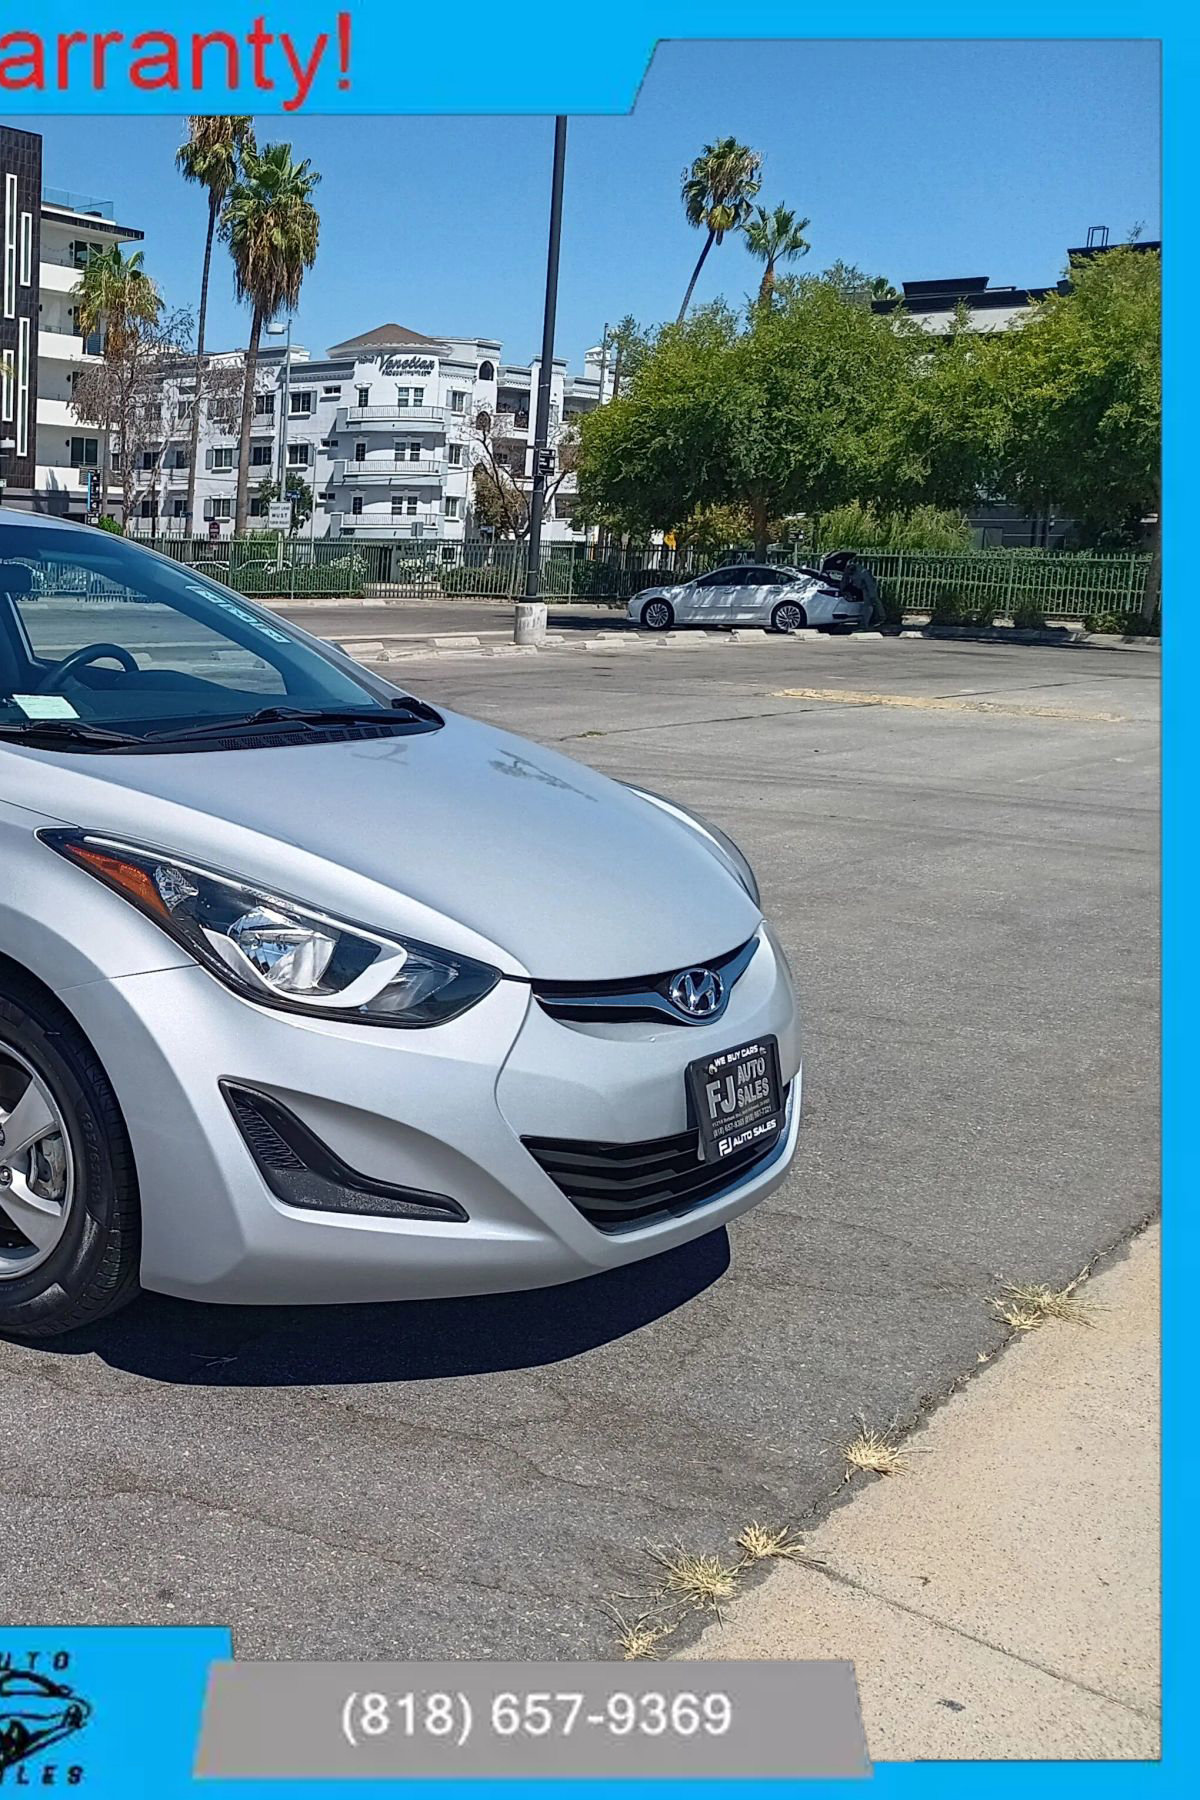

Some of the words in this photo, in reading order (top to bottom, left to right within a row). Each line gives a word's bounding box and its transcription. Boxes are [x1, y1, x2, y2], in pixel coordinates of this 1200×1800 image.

[714, 1056, 726, 1067] WE
[727, 1051, 740, 1062] BUY
[741, 1045, 758, 1058] CARS
[737, 1057, 765, 1085] AUTO
[706, 1075, 736, 1119] FJ
[737, 1077, 769, 1108] SALES
[718, 1136, 733, 1157] FJ
[733, 1130, 753, 1147] AUTO
[752, 1118, 777, 1137] SALES
